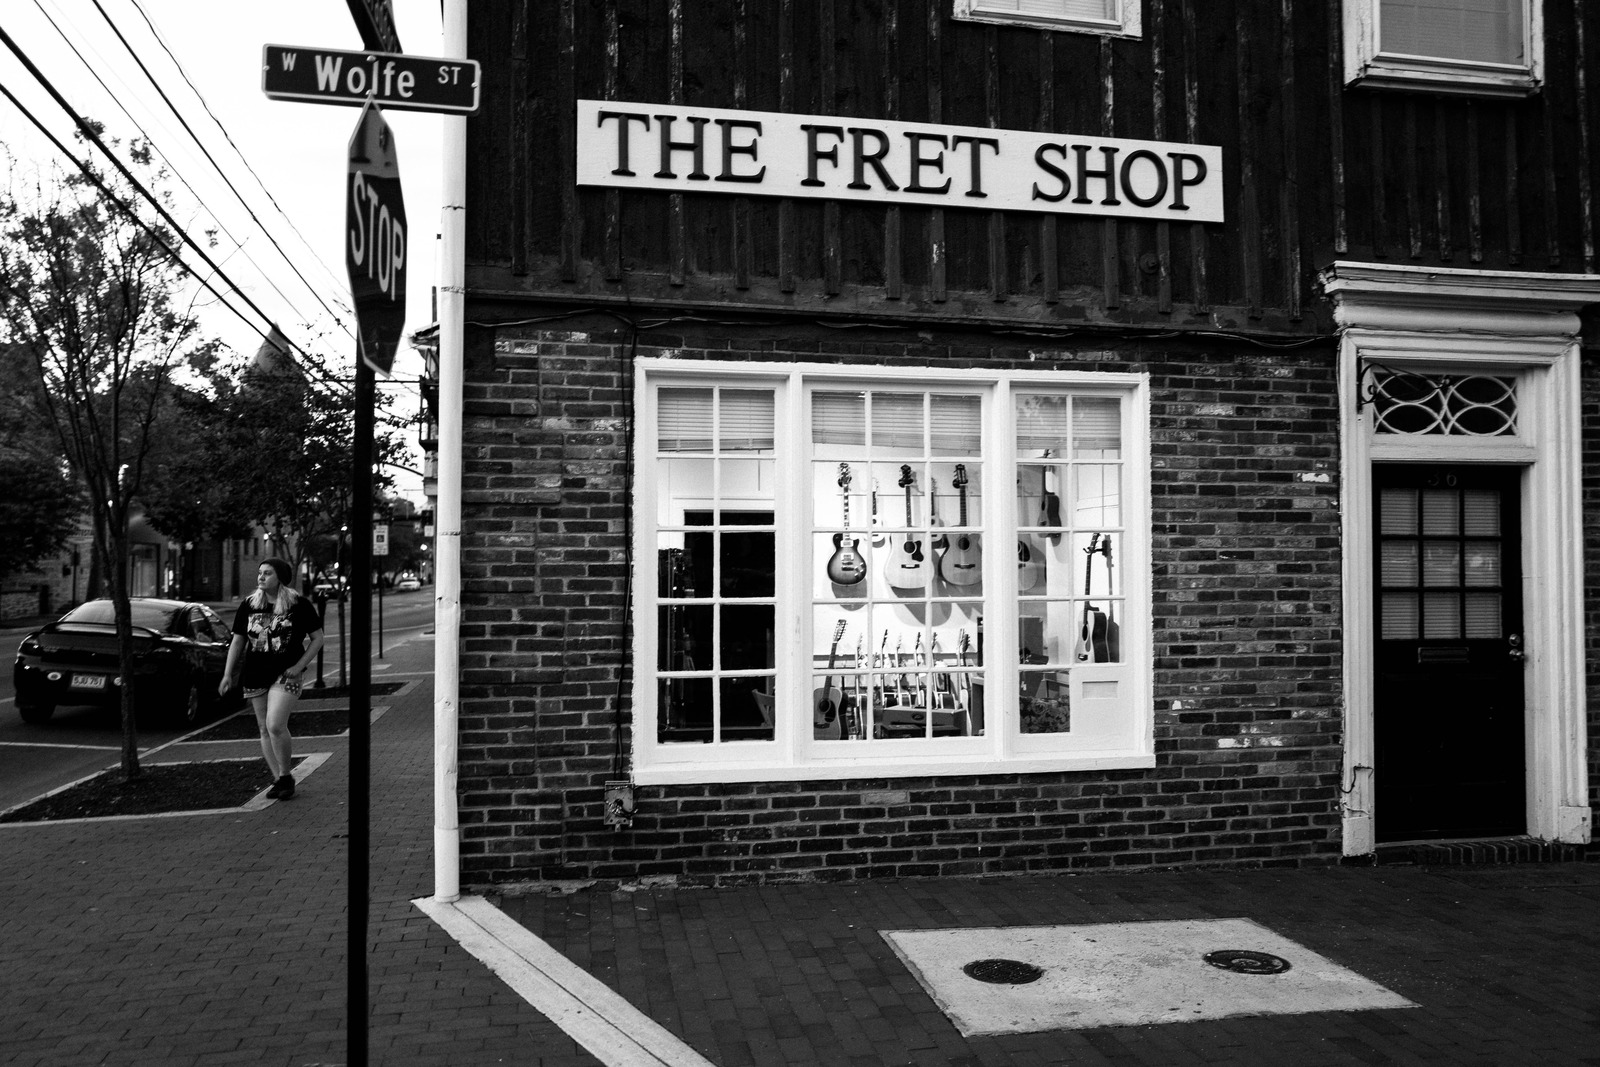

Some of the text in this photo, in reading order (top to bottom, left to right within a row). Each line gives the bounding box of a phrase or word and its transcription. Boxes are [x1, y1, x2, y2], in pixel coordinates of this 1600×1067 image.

[282, 52, 462, 98] W Wolfe ST
[597, 110, 1207, 211] THE FRET SHOP
[351, 170, 404, 302] STOP
[1427, 469, 1457, 487] 36
